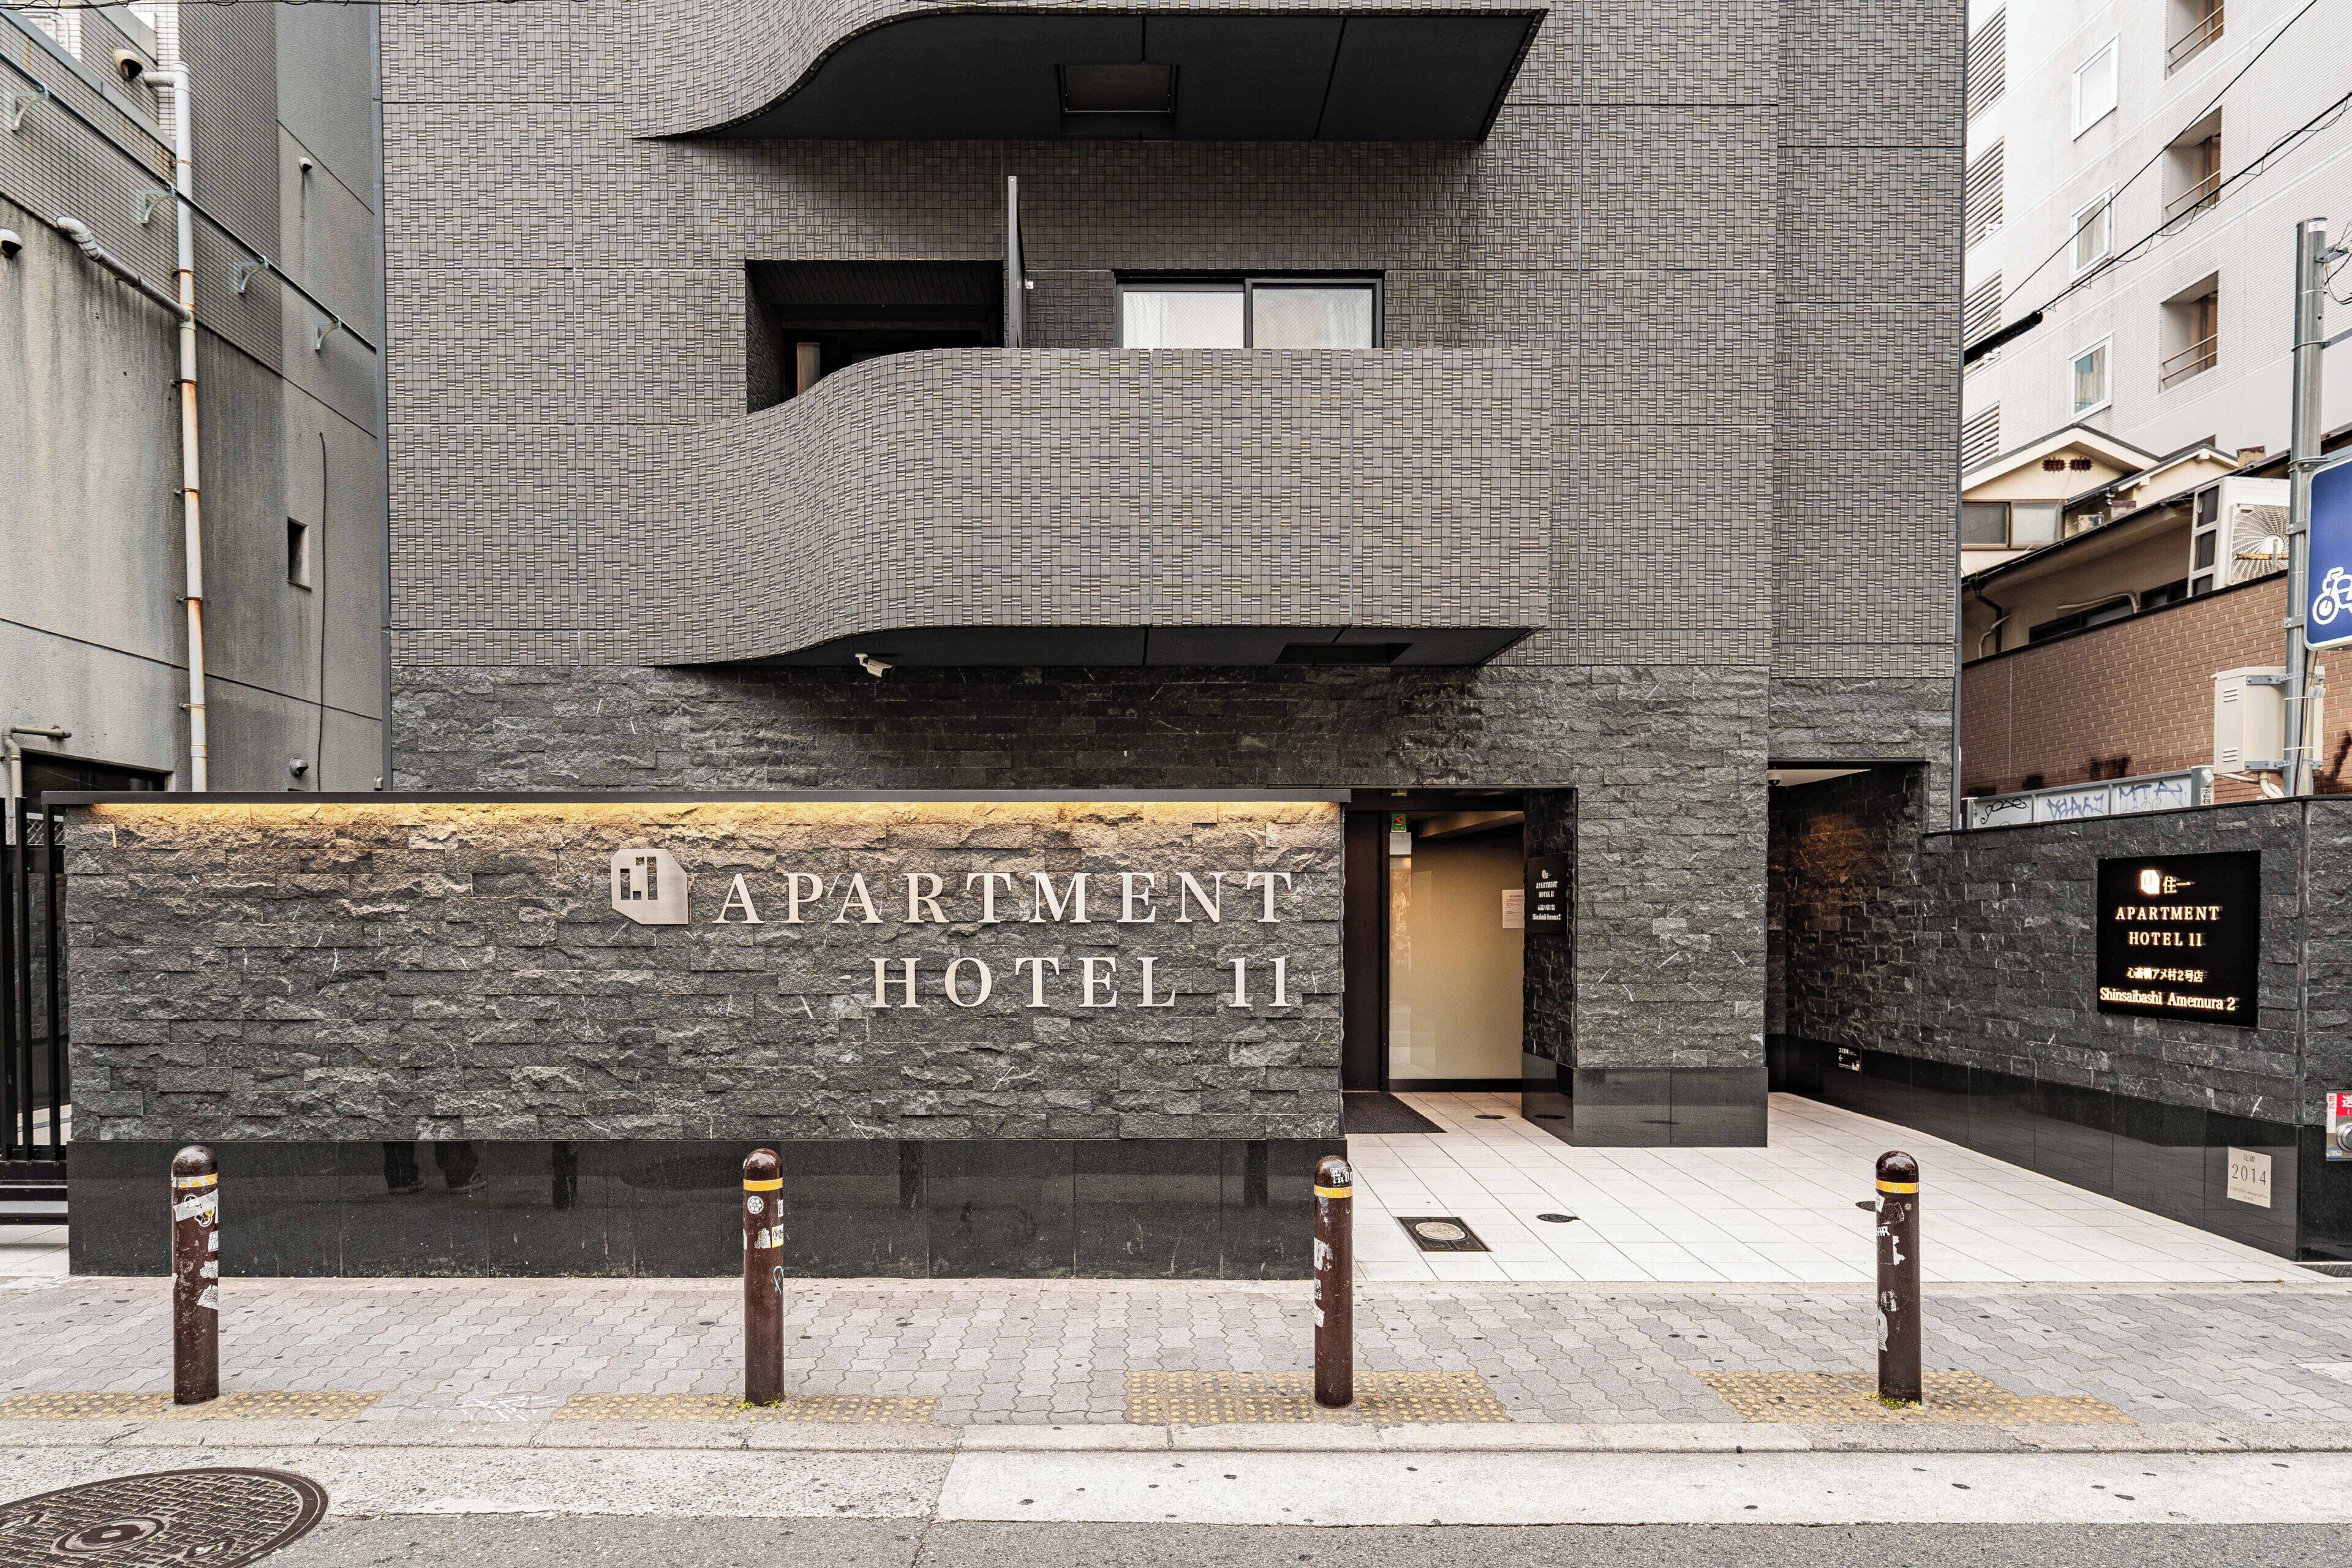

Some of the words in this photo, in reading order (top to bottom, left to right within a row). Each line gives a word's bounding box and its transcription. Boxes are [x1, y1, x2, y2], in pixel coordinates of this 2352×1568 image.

[712, 871, 1292, 924] APARTMENT
[2115, 906, 2220, 921] APARTMENT
[2128, 932, 2184, 946] HOTEL
[2188, 933, 2203, 947] 11
[870, 957, 1177, 1008] HOTEL
[1229, 956, 1292, 1008] 11
[2099, 987, 2163, 1006] Shinsaibashi
[2167, 992, 2224, 1011] Amemura
[2226, 997, 2236, 1011] 2
[2231, 1164, 2267, 1186] 2014
